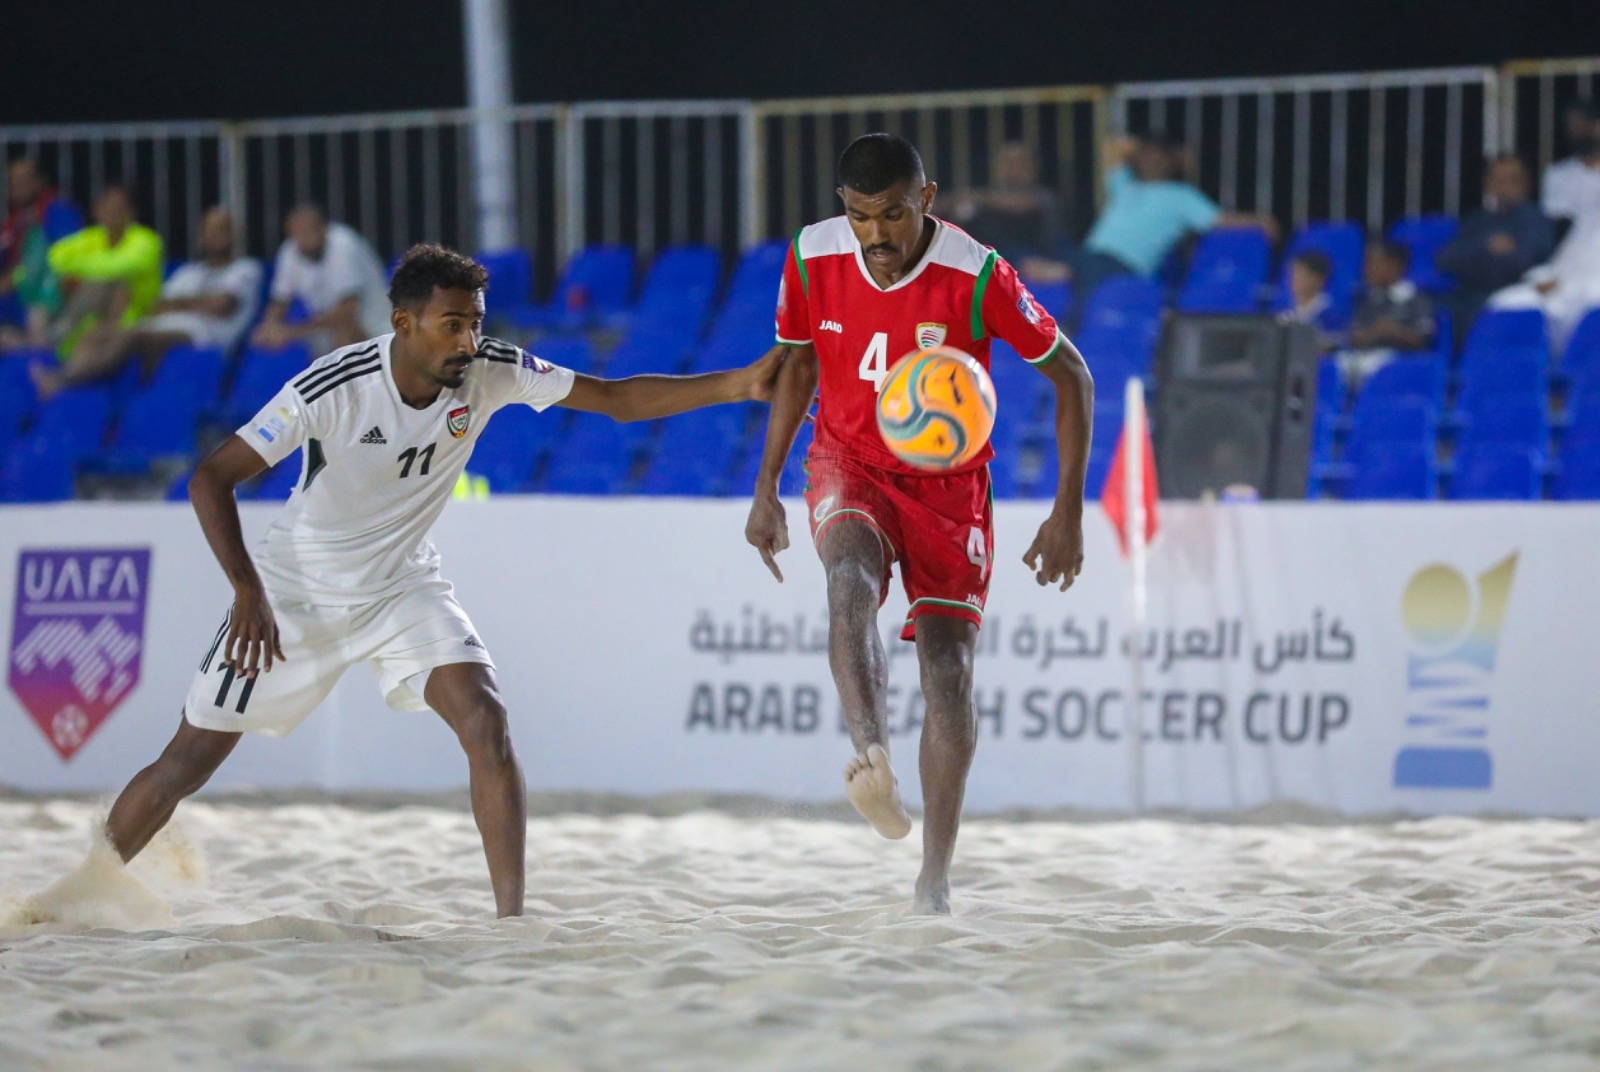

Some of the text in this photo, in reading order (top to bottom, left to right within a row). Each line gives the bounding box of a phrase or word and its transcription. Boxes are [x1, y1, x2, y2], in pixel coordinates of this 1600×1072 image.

[858, 331, 890, 393] 4
[397, 441, 438, 479] 11
[23, 556, 140, 601] UAFA
[1011, 614, 1108, 672] لكرة
[1252, 605, 1357, 675] كأس
[214, 659, 261, 714] 11
[685, 682, 822, 735] ARAB
[1243, 690, 1351, 746] CUP
